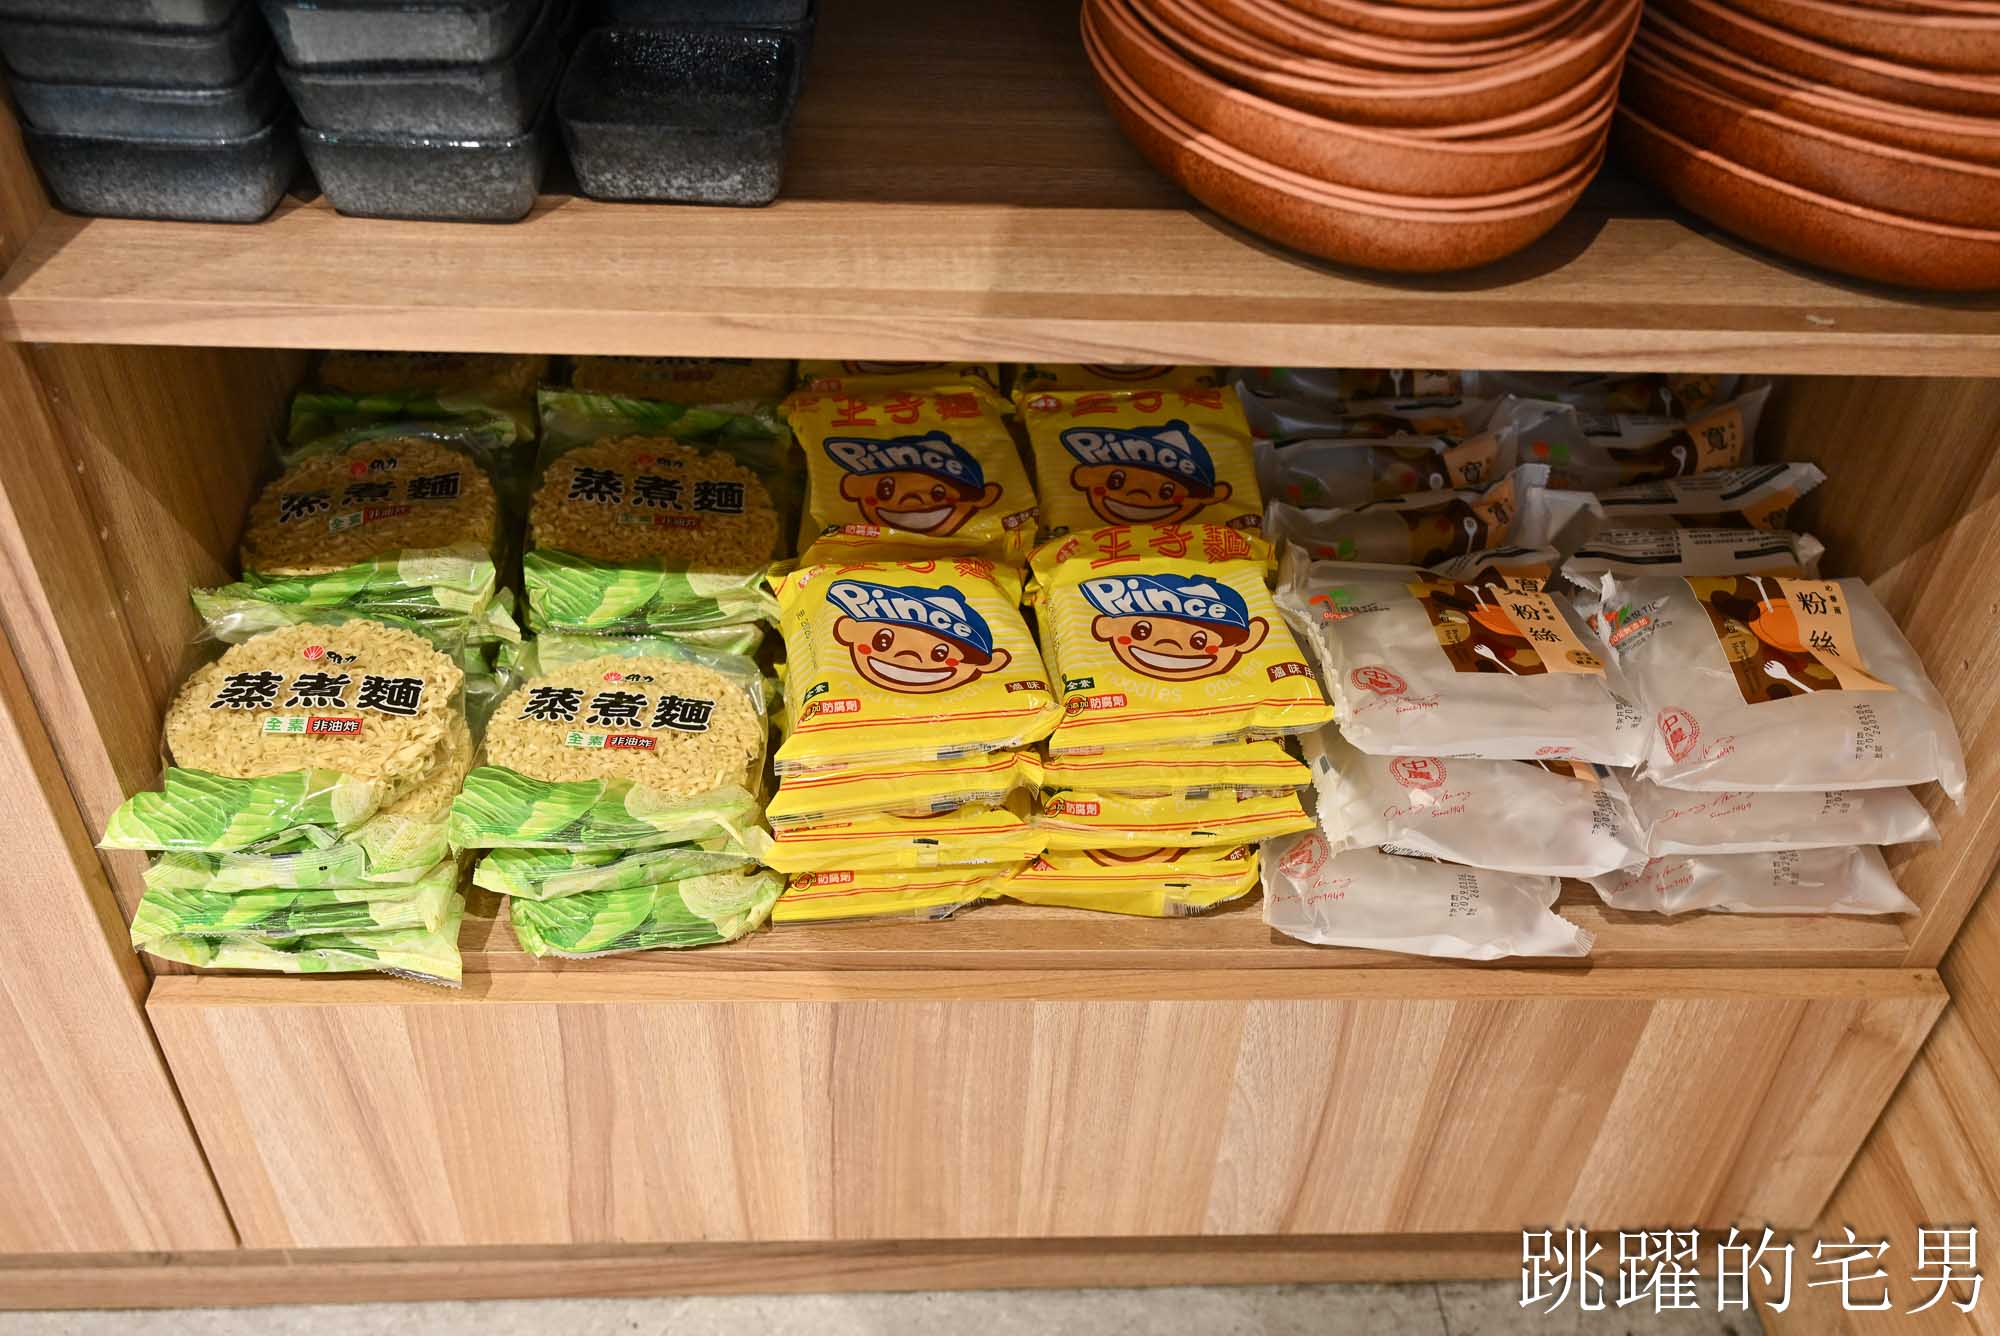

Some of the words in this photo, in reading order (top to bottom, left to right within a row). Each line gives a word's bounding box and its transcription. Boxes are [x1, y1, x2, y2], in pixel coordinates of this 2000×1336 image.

[827, 441, 964, 476] Prince
[1065, 432, 1196, 475] Prince
[568, 466, 744, 513] 蒸煮麵
[1090, 523, 1251, 569] 王子麵
[829, 583, 973, 637] Prince
[1084, 578, 1228, 618] Prince
[209, 671, 424, 716] 蒸煮麵
[518, 686, 714, 732] 蒸煮麵
[266, 718, 306, 732] 全素
[312, 720, 360, 733] 非油炸
[567, 732, 603, 746] 全素
[610, 737, 654, 748] 非油炸
